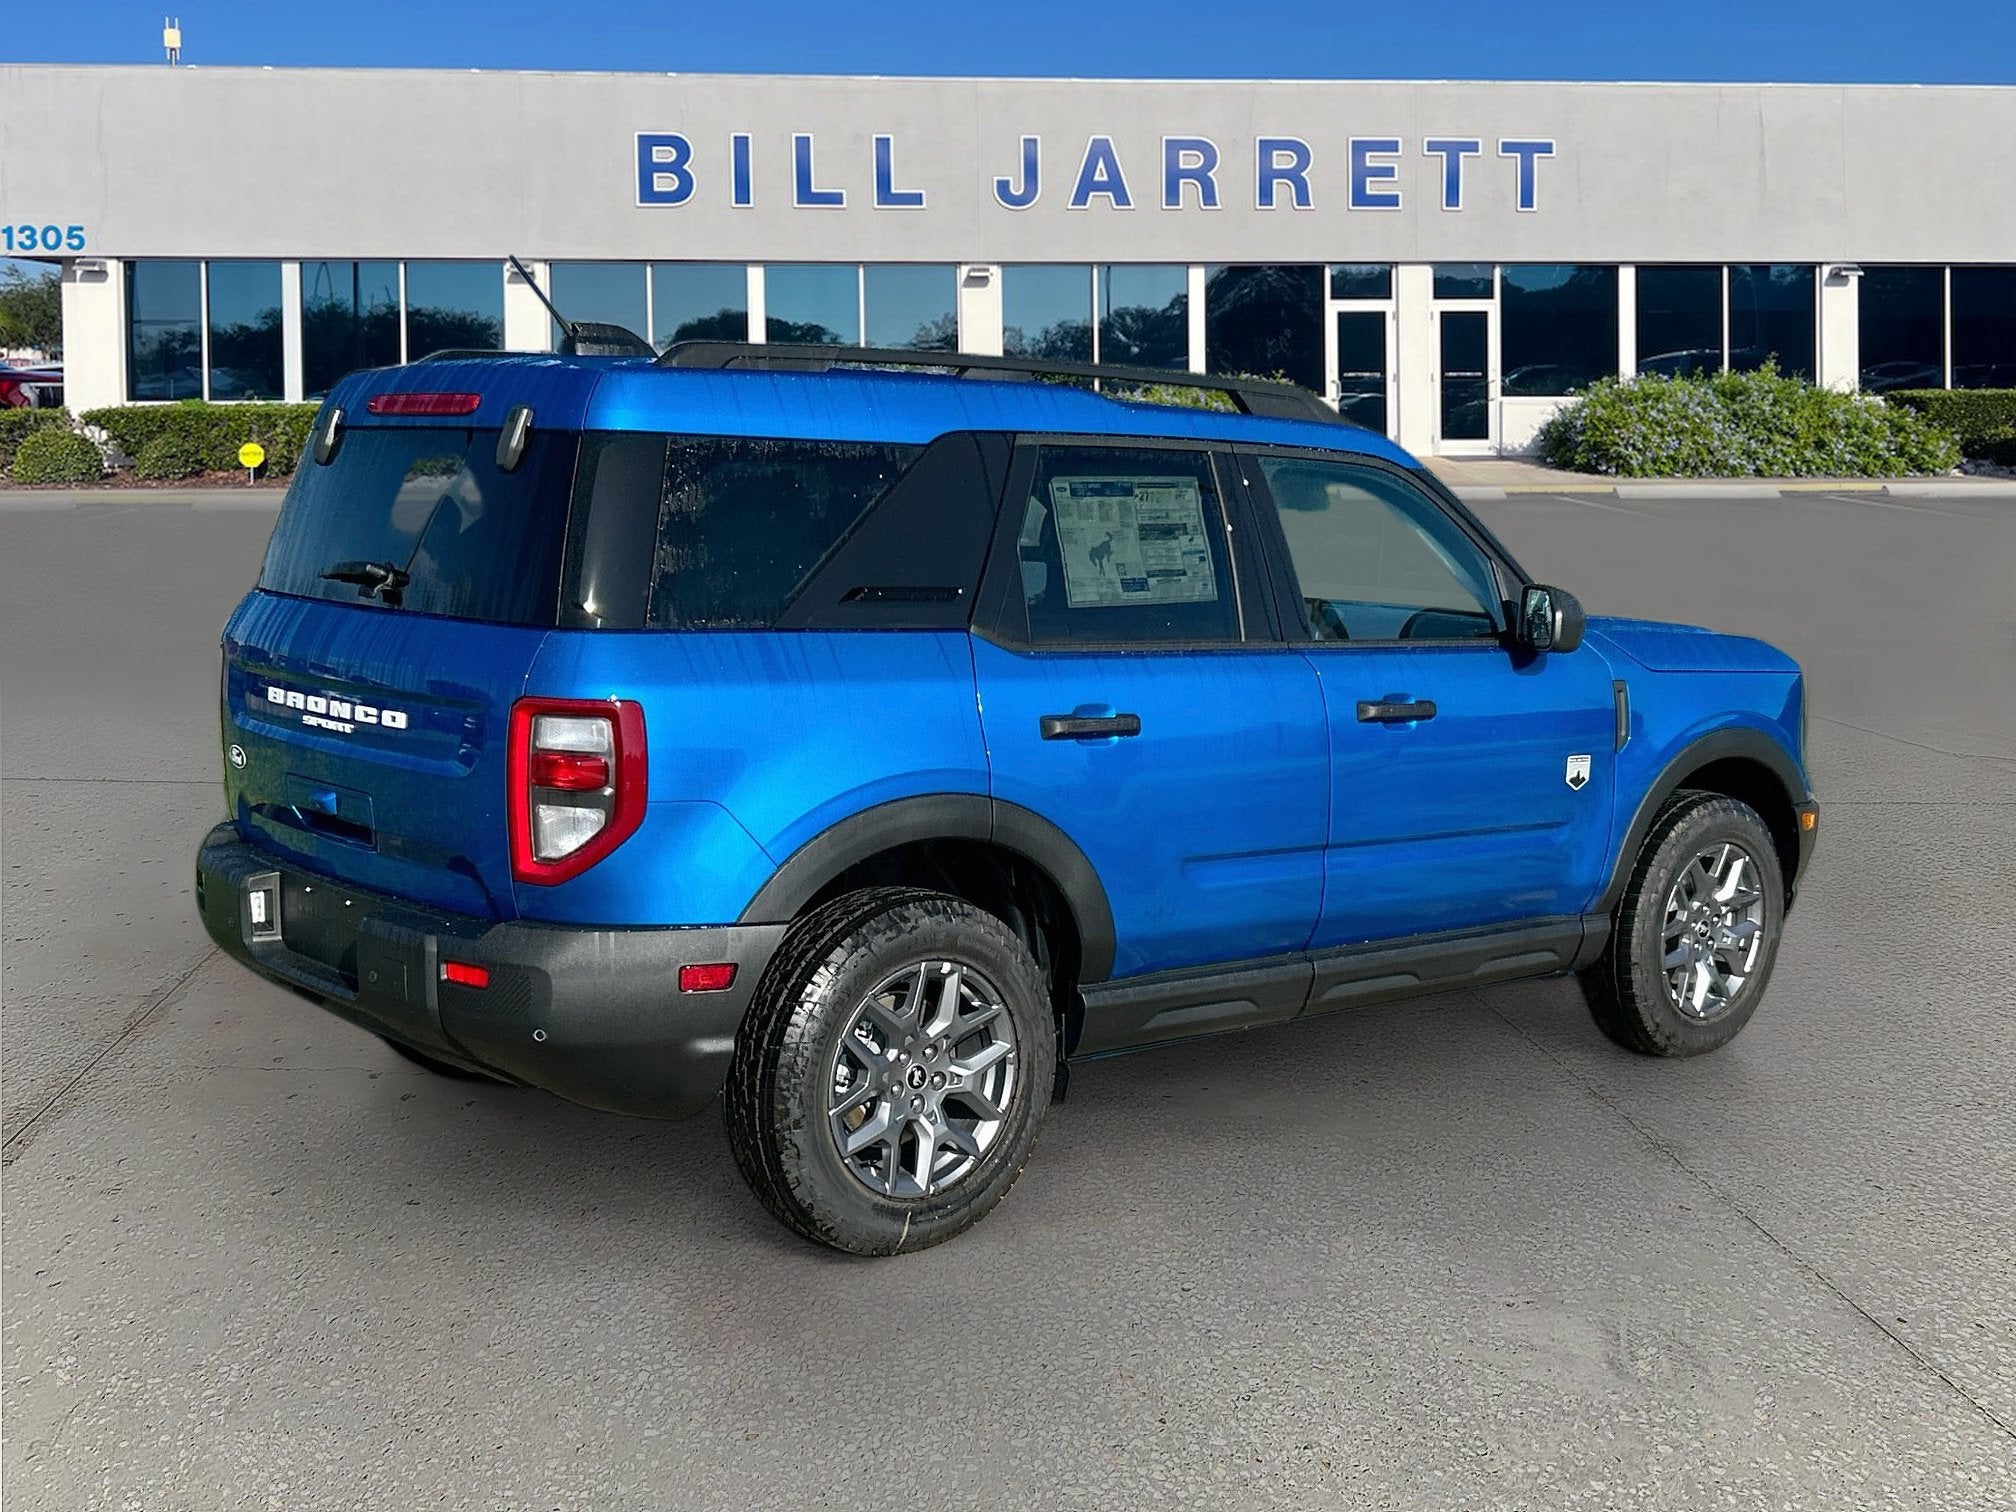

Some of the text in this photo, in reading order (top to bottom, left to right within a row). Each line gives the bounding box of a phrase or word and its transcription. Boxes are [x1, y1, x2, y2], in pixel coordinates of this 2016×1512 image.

[634, 132, 1557, 212] BILL JARRETT
[1, 225, 86, 251] 1305
[267, 686, 409, 730] BRONCO
[302, 715, 355, 733] SPORT
